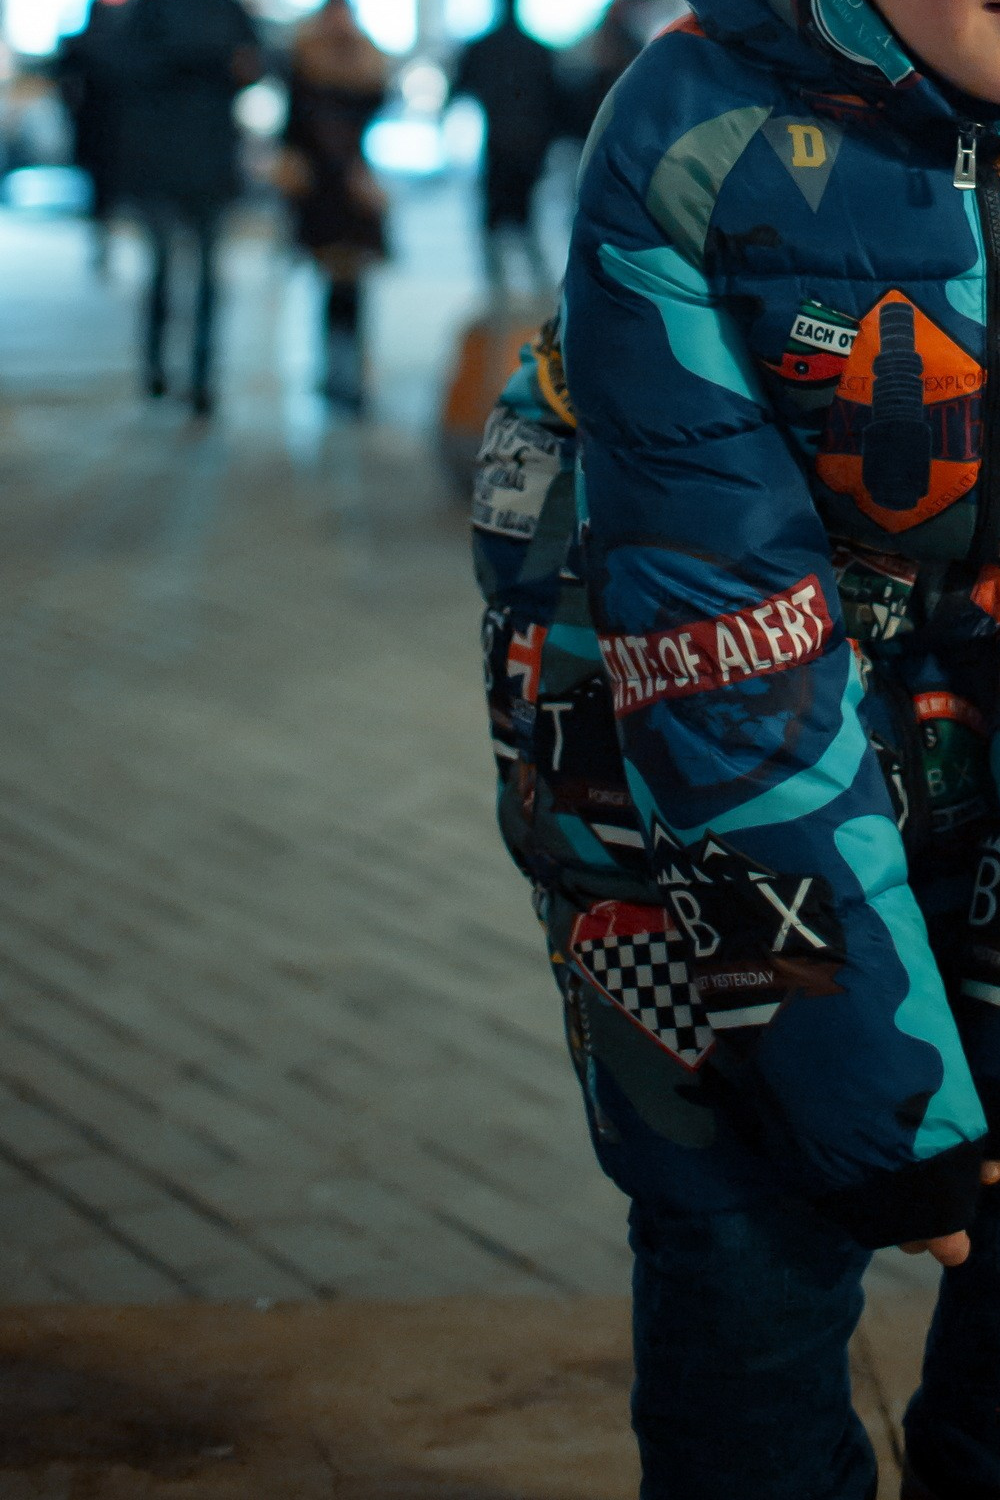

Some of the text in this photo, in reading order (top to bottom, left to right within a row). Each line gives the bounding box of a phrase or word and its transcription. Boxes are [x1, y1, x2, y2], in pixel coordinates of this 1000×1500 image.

[787, 124, 826, 168] D
[795, 321, 835, 344] EACH
[658, 633, 701, 687] OF
[716, 584, 824, 682] ALERT
[541, 702, 575, 772] T
[669, 877, 828, 958] B X
